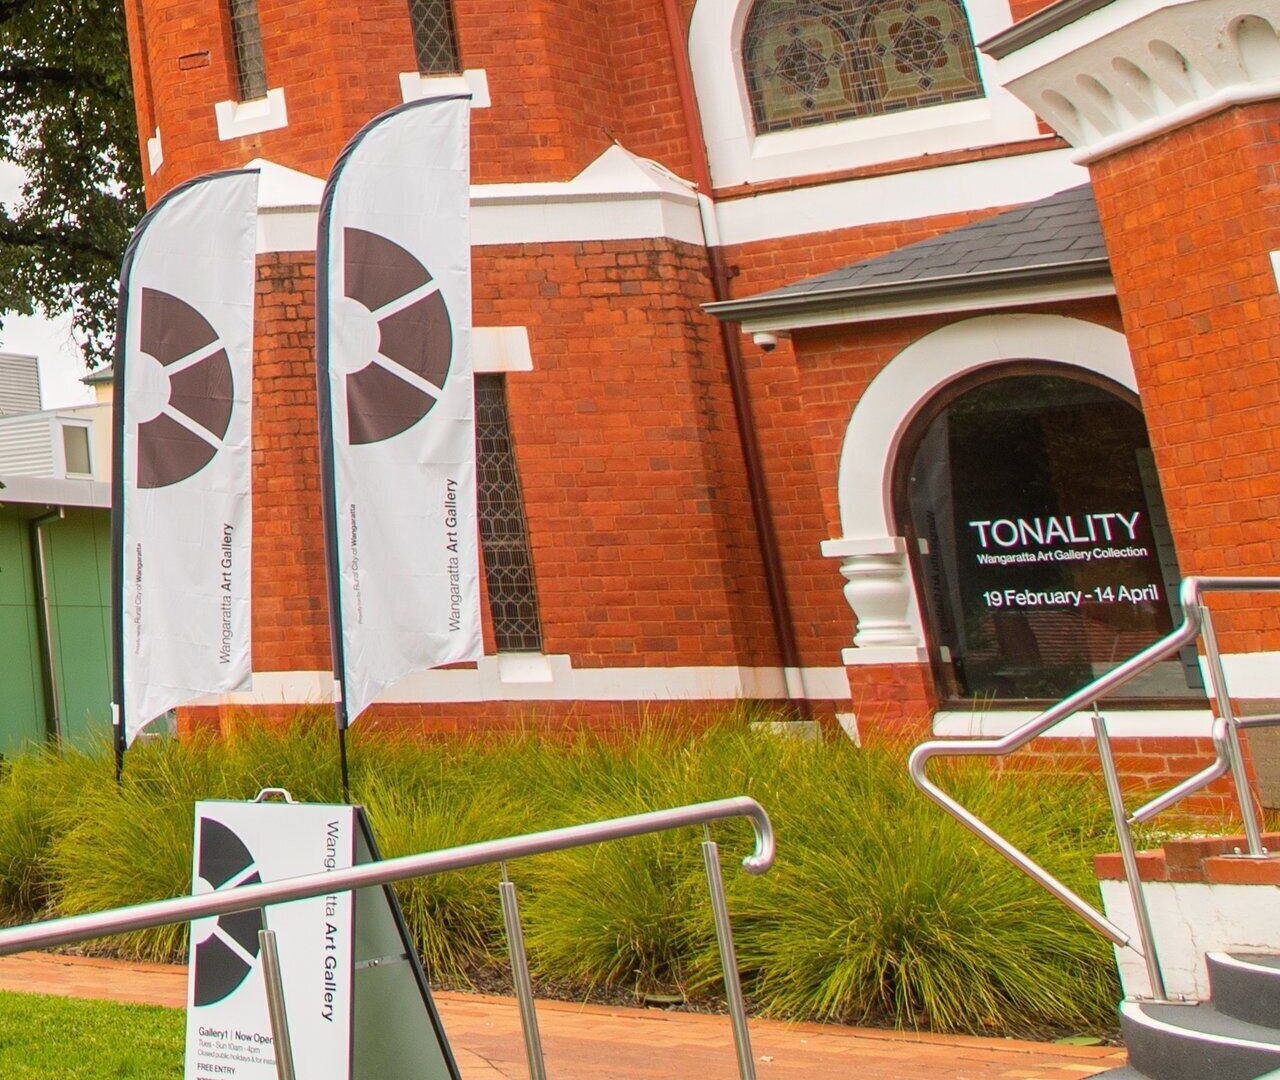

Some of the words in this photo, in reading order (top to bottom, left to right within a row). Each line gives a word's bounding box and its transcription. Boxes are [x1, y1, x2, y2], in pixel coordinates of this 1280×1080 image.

[445, 478, 458, 527] Gallery
[968, 511, 1140, 548] TONALITY
[221, 523, 234, 568] Gallery
[447, 532, 458, 552] Art
[135, 542, 143, 582] Wangaratta
[351, 555, 359, 570] City
[976, 552, 1037, 565] Wangaratta
[1037, 550, 1053, 561] Art
[1054, 549, 1092, 561] Gallery
[1092, 546, 1148, 559] Collection
[221, 572, 232, 591] Art
[352, 571, 360, 590] Rural
[135, 591, 143, 605] City
[449, 557, 462, 632] Wangaratta
[983, 590, 1002, 607] 19
[1003, 589, 1082, 607] February
[1094, 586, 1115, 602] 14
[1117, 583, 1159, 604] April
[219, 596, 234, 664] Wangaratta
[323, 820, 340, 917] Wangtta
[325, 922, 338, 950] Art
[321, 955, 338, 1022] Gallery
[215, 1041, 227, 1049] Sun
[247, 1045, 261, 1054] 4pm
[235, 1031, 252, 1042] Now
[197, 1062, 213, 1072] FREE
[214, 1065, 236, 1076] ENTRY
